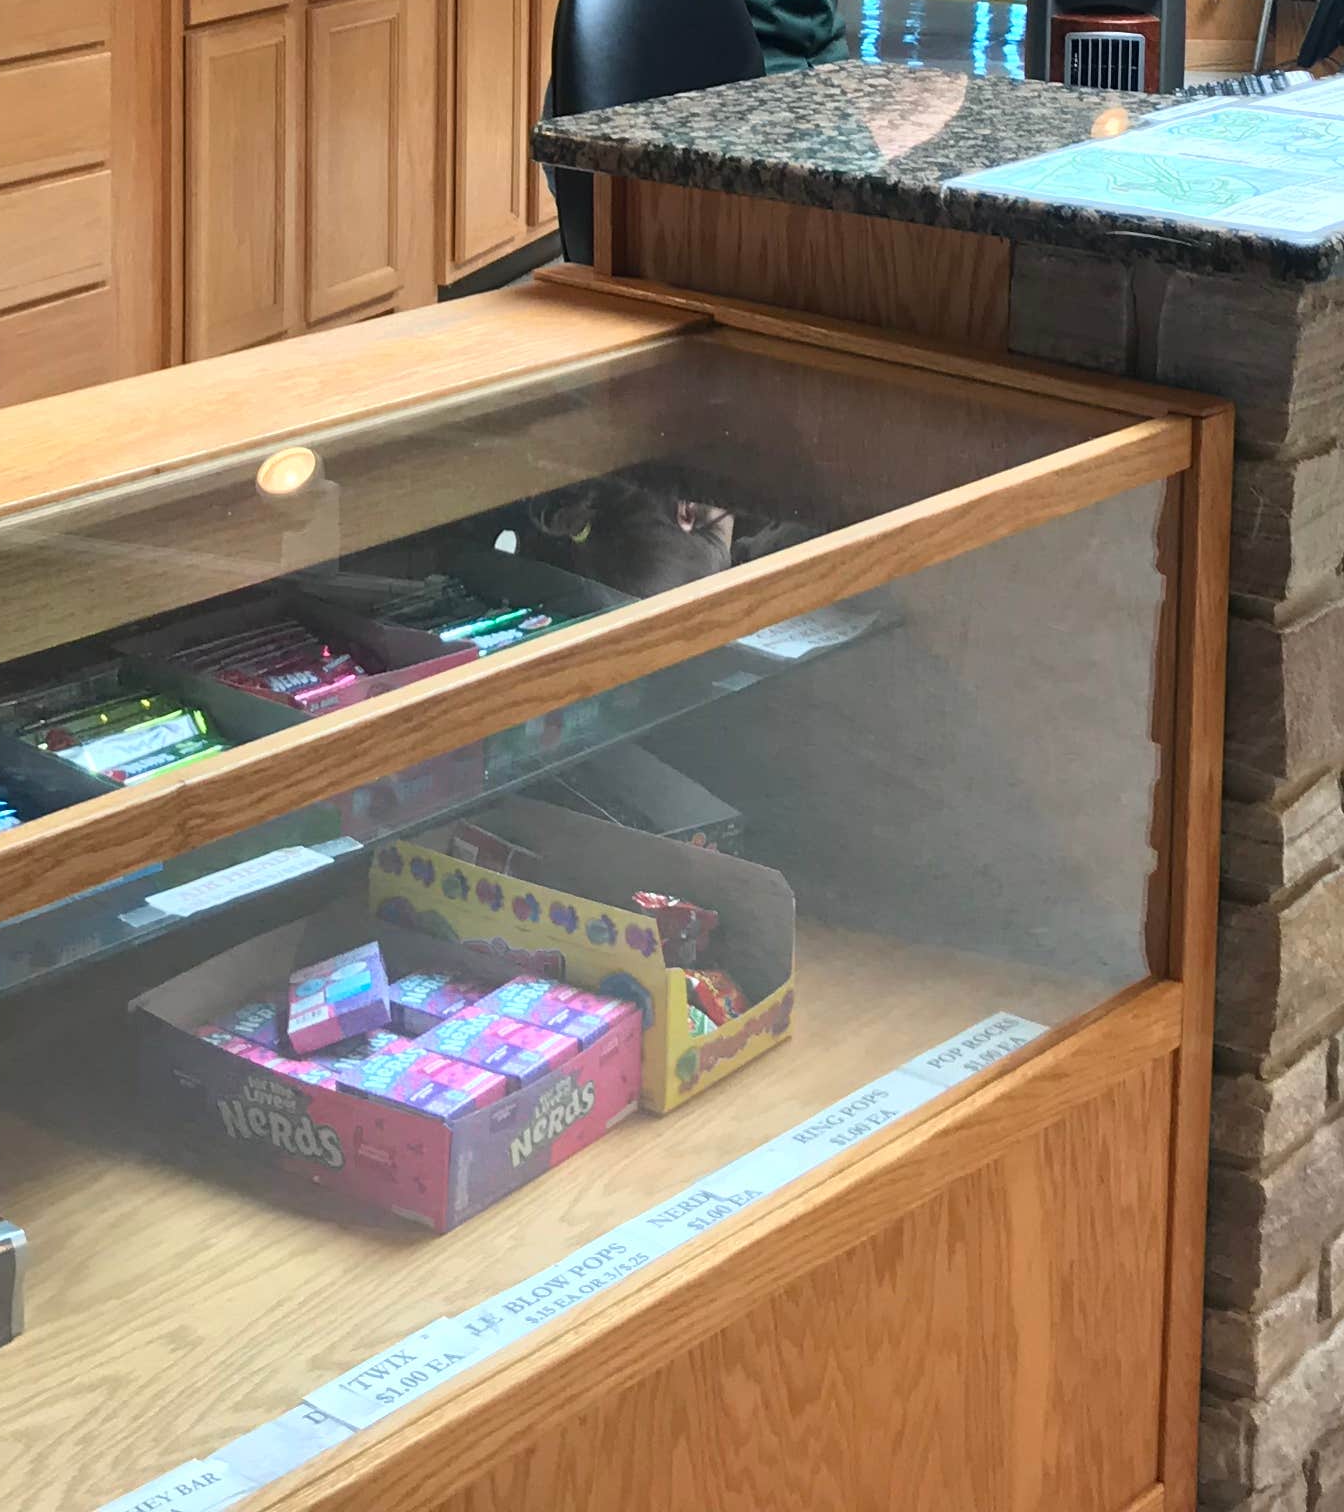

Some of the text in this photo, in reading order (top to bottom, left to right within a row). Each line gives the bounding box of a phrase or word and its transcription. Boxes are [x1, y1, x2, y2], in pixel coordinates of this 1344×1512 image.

[927, 1017, 1020, 1070] POP ROCKS
[792, 1087, 890, 1145] RING POPS
[867, 1108, 898, 1128] EA
[502, 1273, 571, 1316] BLOW
[567, 1242, 627, 1278] POPS
[553, 1293, 583, 1309] EA
[347, 1349, 417, 1393] TWIX
[375, 1350, 469, 1406] $1.00 EA
[175, 1472, 222, 1496] BAR
